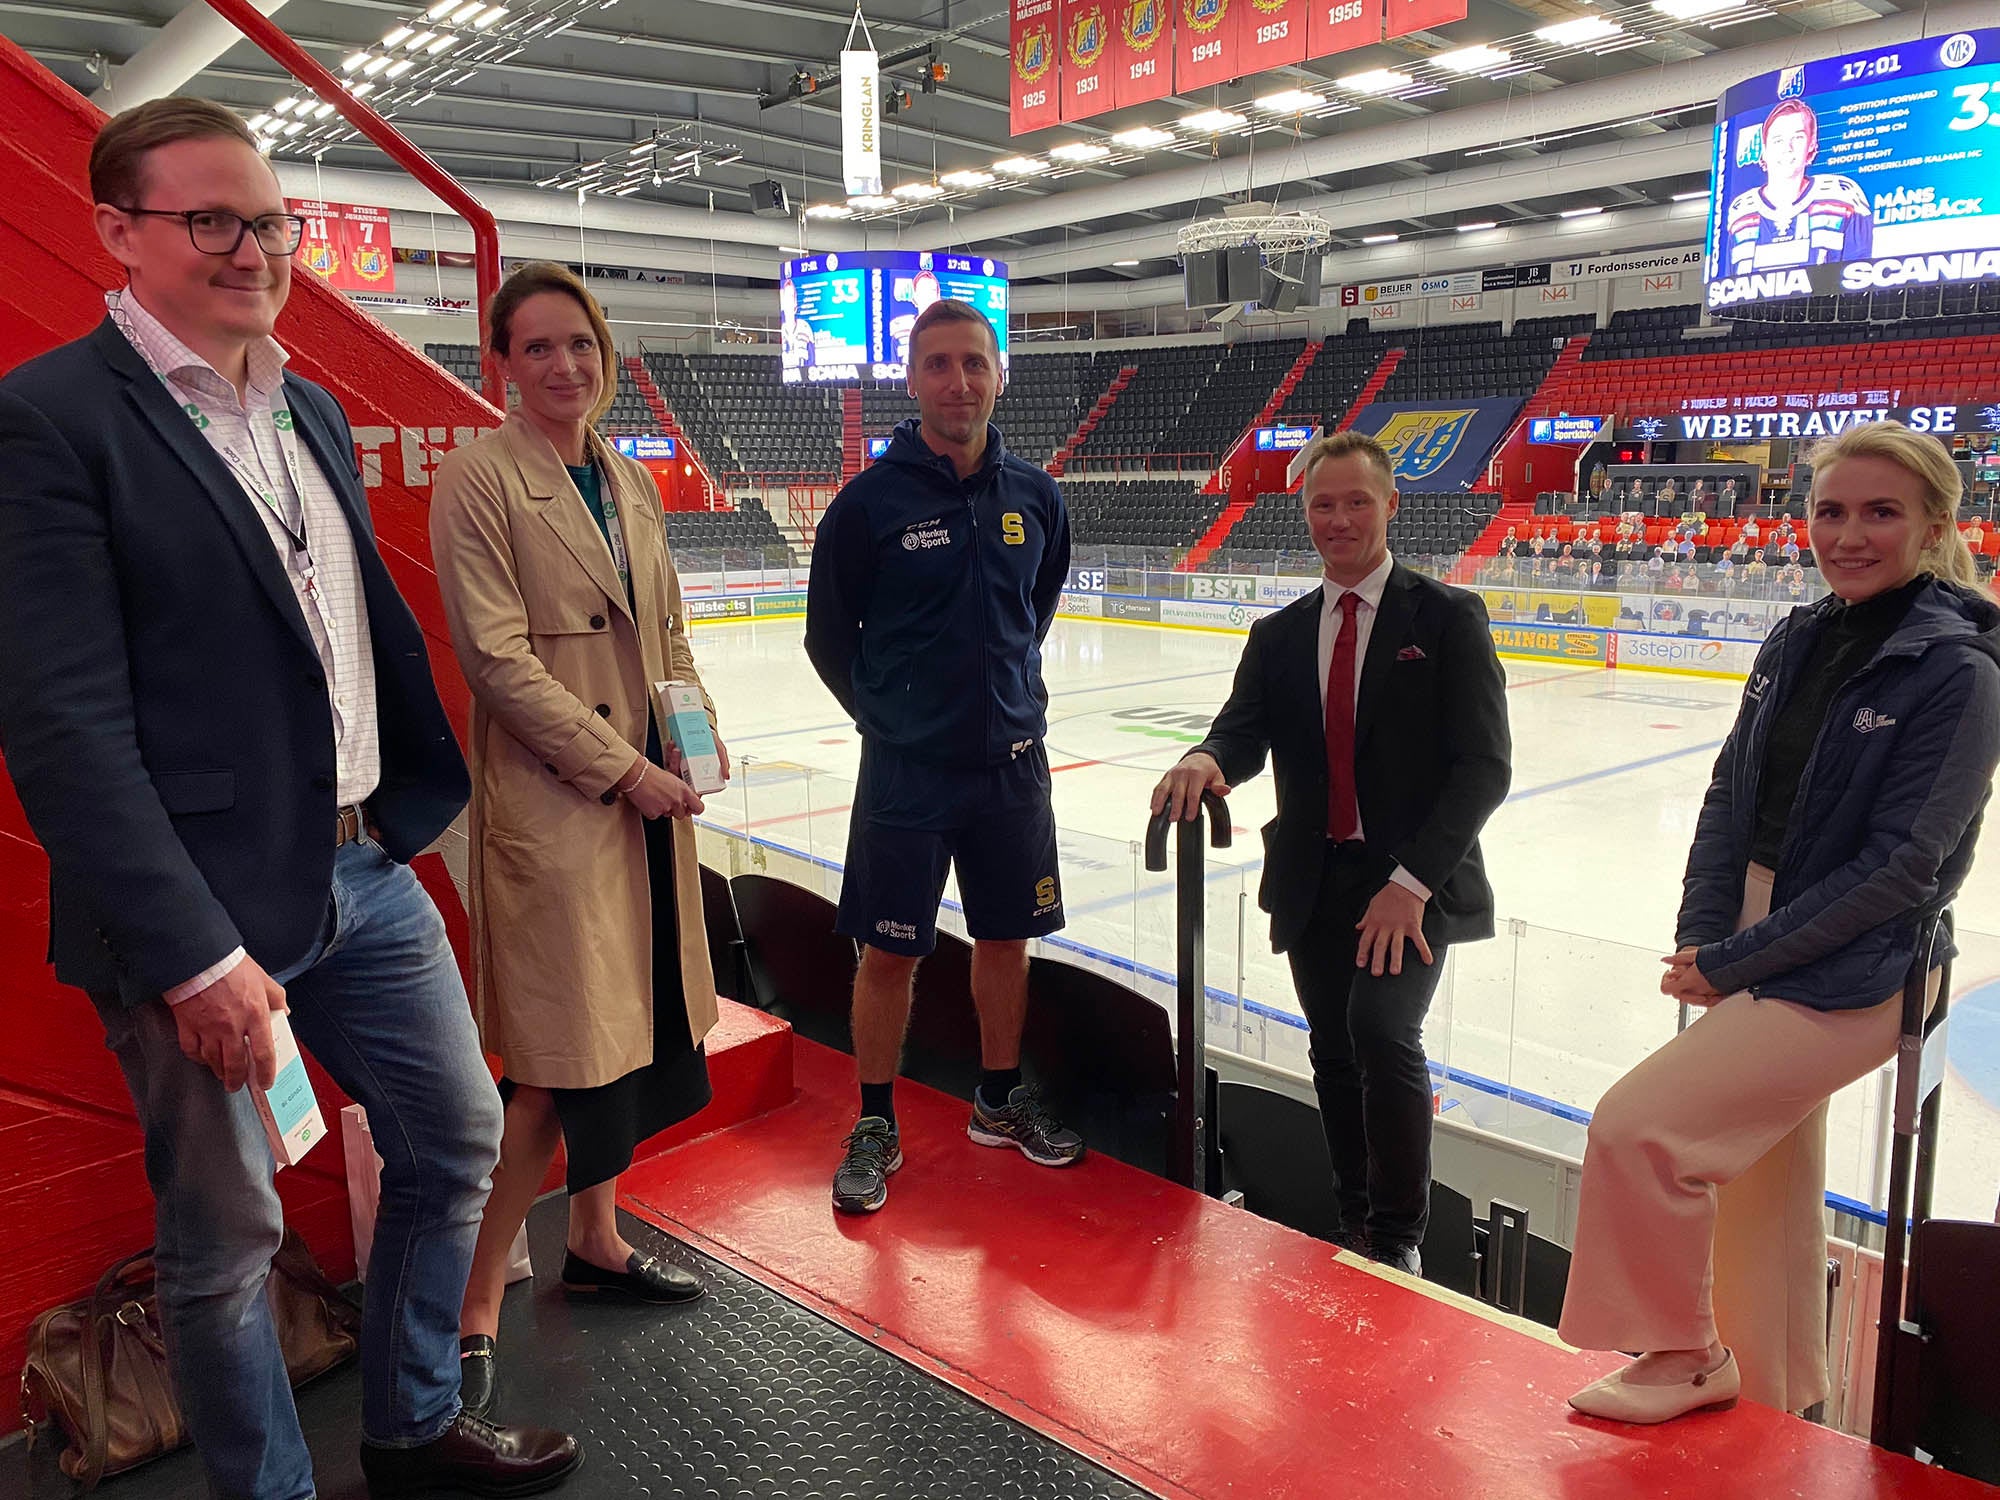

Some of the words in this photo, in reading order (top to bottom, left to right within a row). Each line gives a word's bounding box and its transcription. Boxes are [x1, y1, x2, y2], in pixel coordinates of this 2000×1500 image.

[1016, 0, 1052, 21] MÄSTARE
[1328, 0, 1362, 25] 1956
[1256, 20, 1289, 45] 1953
[1191, 40, 1222, 63] 1944
[1129, 59, 1156, 79] 1941
[1841, 54, 1902, 82] 17:01
[1076, 75, 1099, 95] 1931
[1022, 90, 1046, 109] 1925
[1889, 90, 1938, 105] FORWARD
[862, 76, 874, 153] KRINGLAN
[1892, 122, 1907, 131] CM
[1832, 142, 1852, 153] VIKT
[1827, 153, 1864, 166] SHOOTS
[1865, 148, 1893, 160] RIGHT
[1858, 157, 1923, 174] MODERKLUBB
[1924, 151, 1966, 164] KALMAR
[302, 201, 329, 210] GLENN
[1873, 185, 1936, 210] MÅNS
[293, 207, 339, 218] JOHANSSON
[344, 212, 388, 223] JOHANSSON
[306, 217, 328, 240] 11
[360, 222, 374, 244] 7
[1569, 263, 1583, 276] TJ
[1587, 255, 1679, 275] Fordonsservice
[1682, 252, 1701, 264] AB
[1841, 250, 2000, 290] SCANIA
[1527, 267, 1539, 280] JB
[831, 277, 860, 304] 33
[1380, 283, 1413, 294] BEIJER
[1644, 275, 1673, 291] N4
[1709, 268, 1813, 307] SCANIA
[1345, 289, 1355, 303] S
[1542, 286, 1569, 301] N4
[1372, 304, 1394, 319] N4
[1452, 295, 1476, 311] N4
[808, 365, 860, 381] SCANIA
[918, 529, 949, 541] Monkey
[1002, 512, 1026, 545] S
[920, 536, 951, 549] Sports
[1191, 577, 1252, 600] BST
[686, 600, 747, 615] hillstedts
[1068, 602, 1090, 613] Sports
[1608, 631, 1617, 663] CCM
[1628, 639, 1699, 662] 3stepIT
[1035, 876, 1056, 907] S
[1032, 902, 1061, 917] CCM
[889, 929, 917, 941] Sports
[890, 920, 917, 932] Monkey
